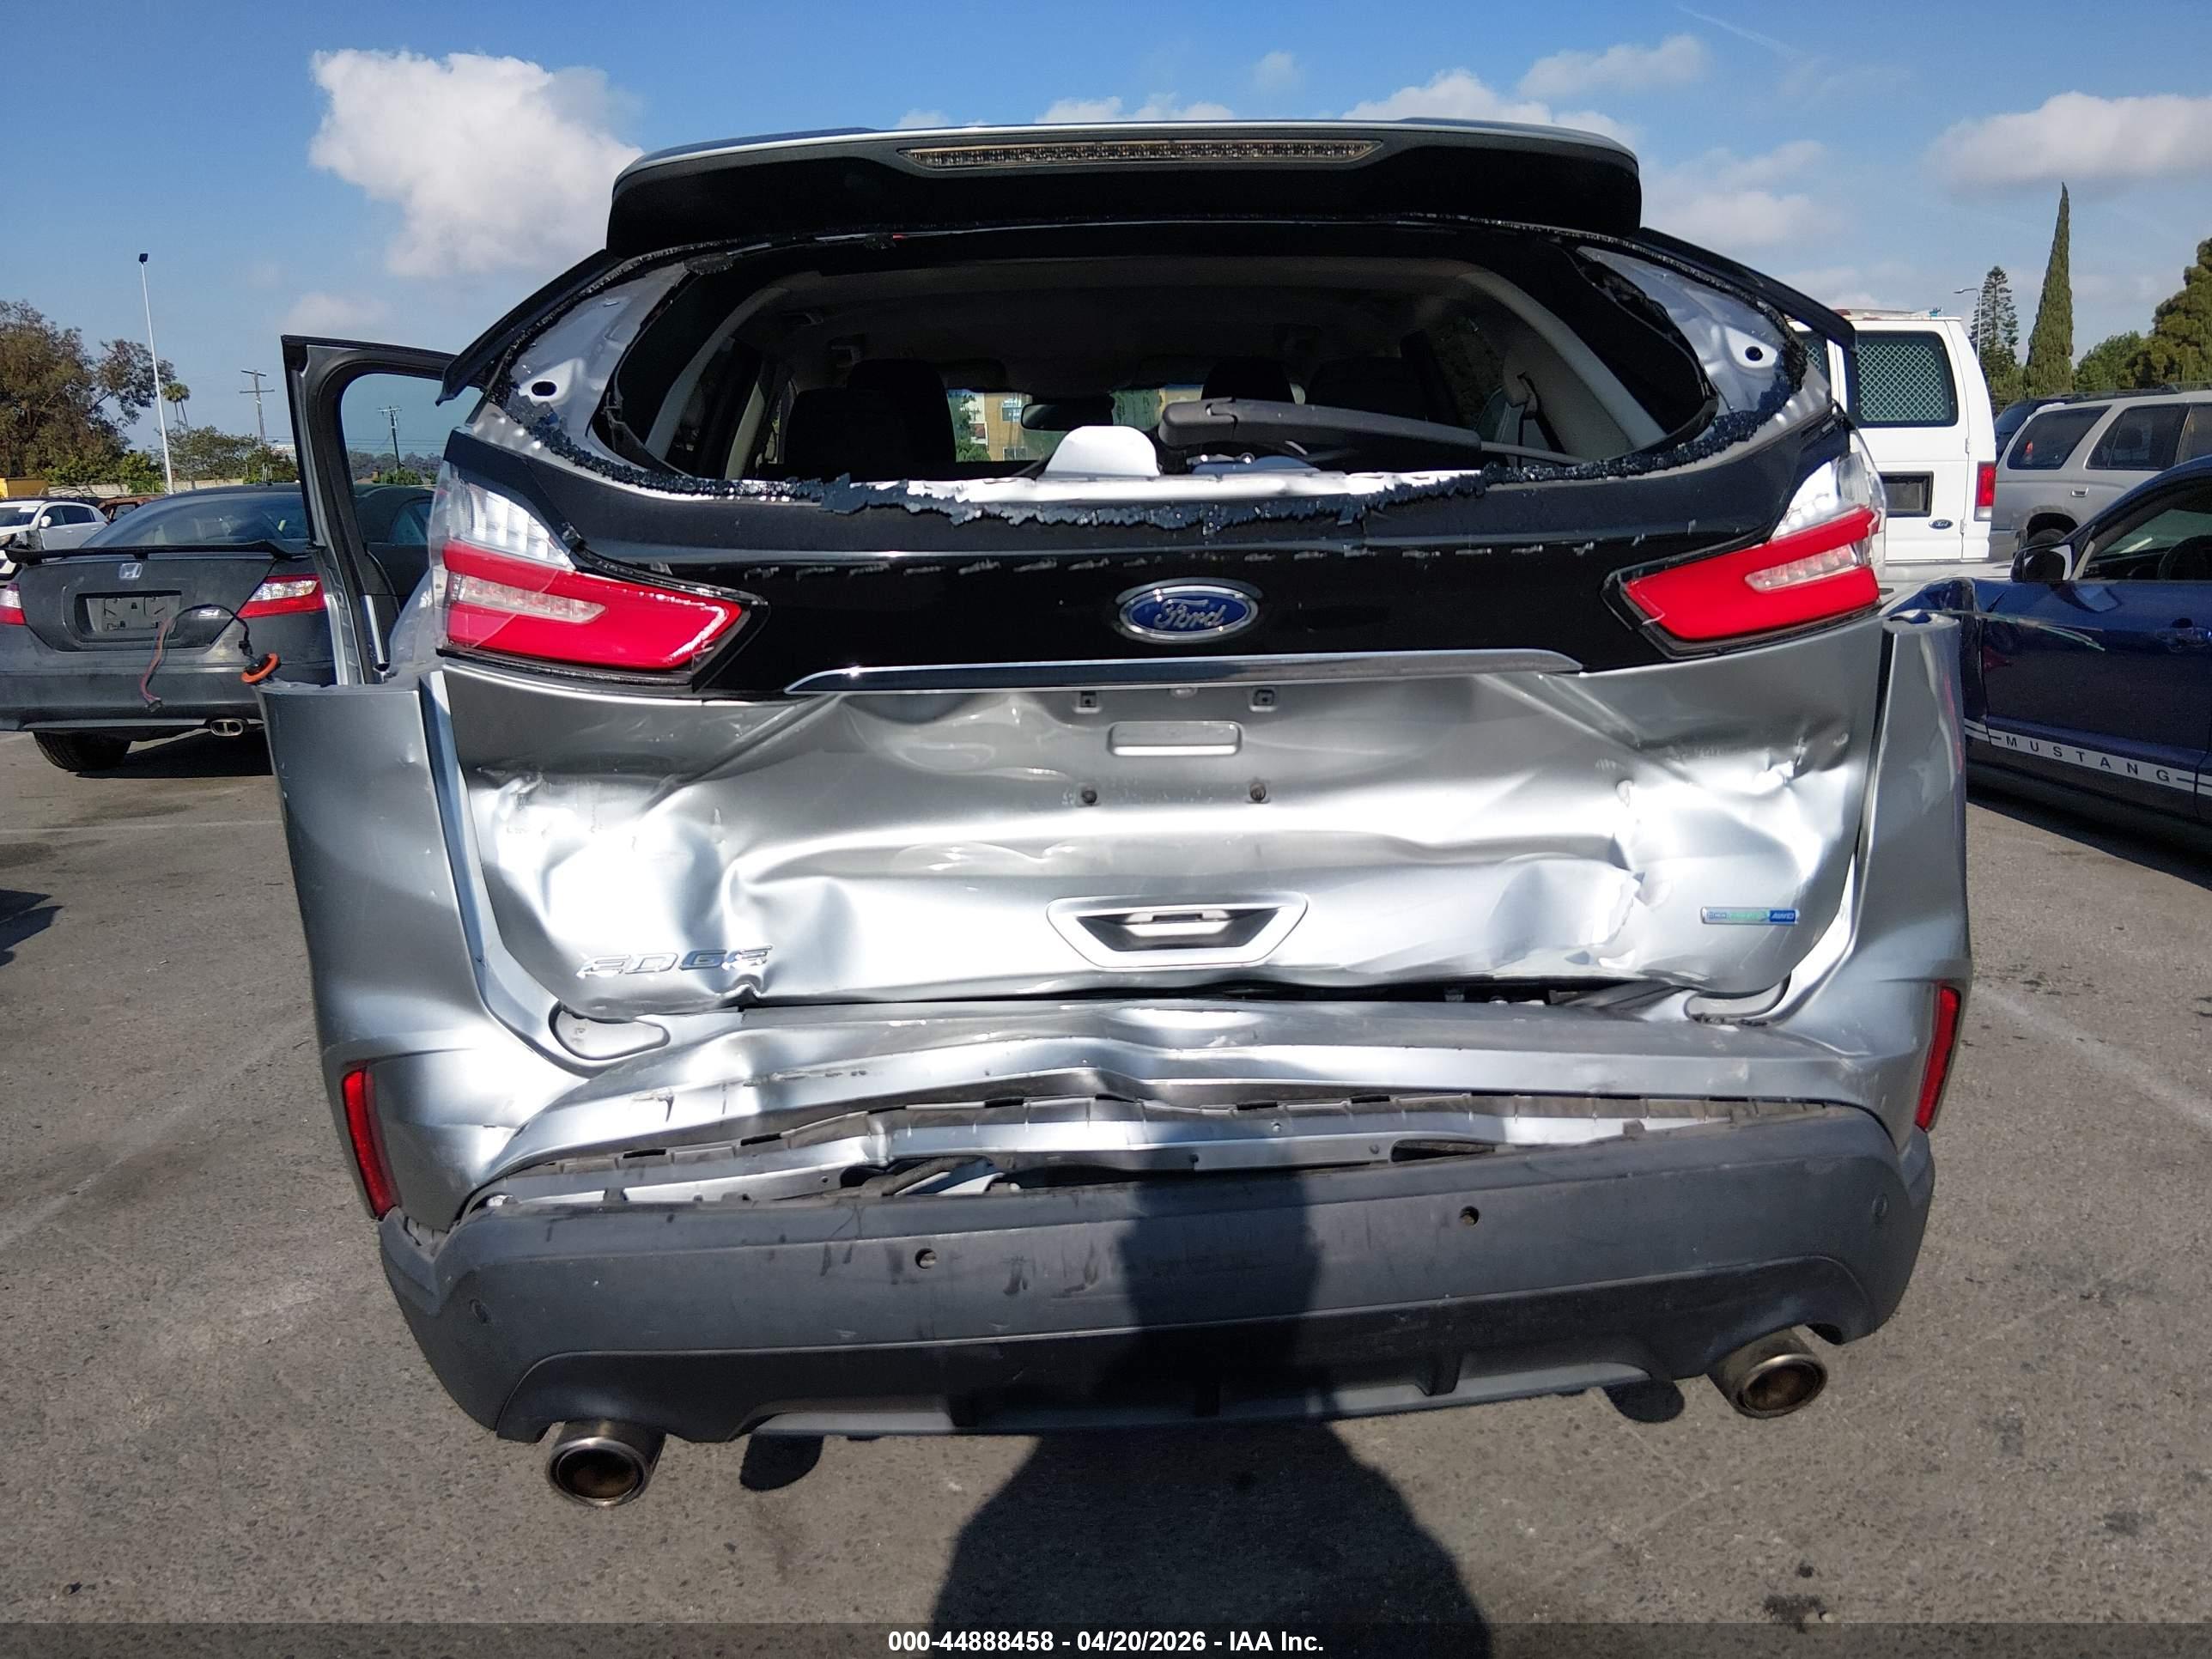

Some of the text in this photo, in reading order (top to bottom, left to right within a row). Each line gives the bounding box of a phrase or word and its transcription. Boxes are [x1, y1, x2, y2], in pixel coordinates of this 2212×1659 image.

[1153, 598, 1227, 629] Ford
[2005, 735, 2172, 783] MUSTANG
[576, 945, 774, 978] EDGE
